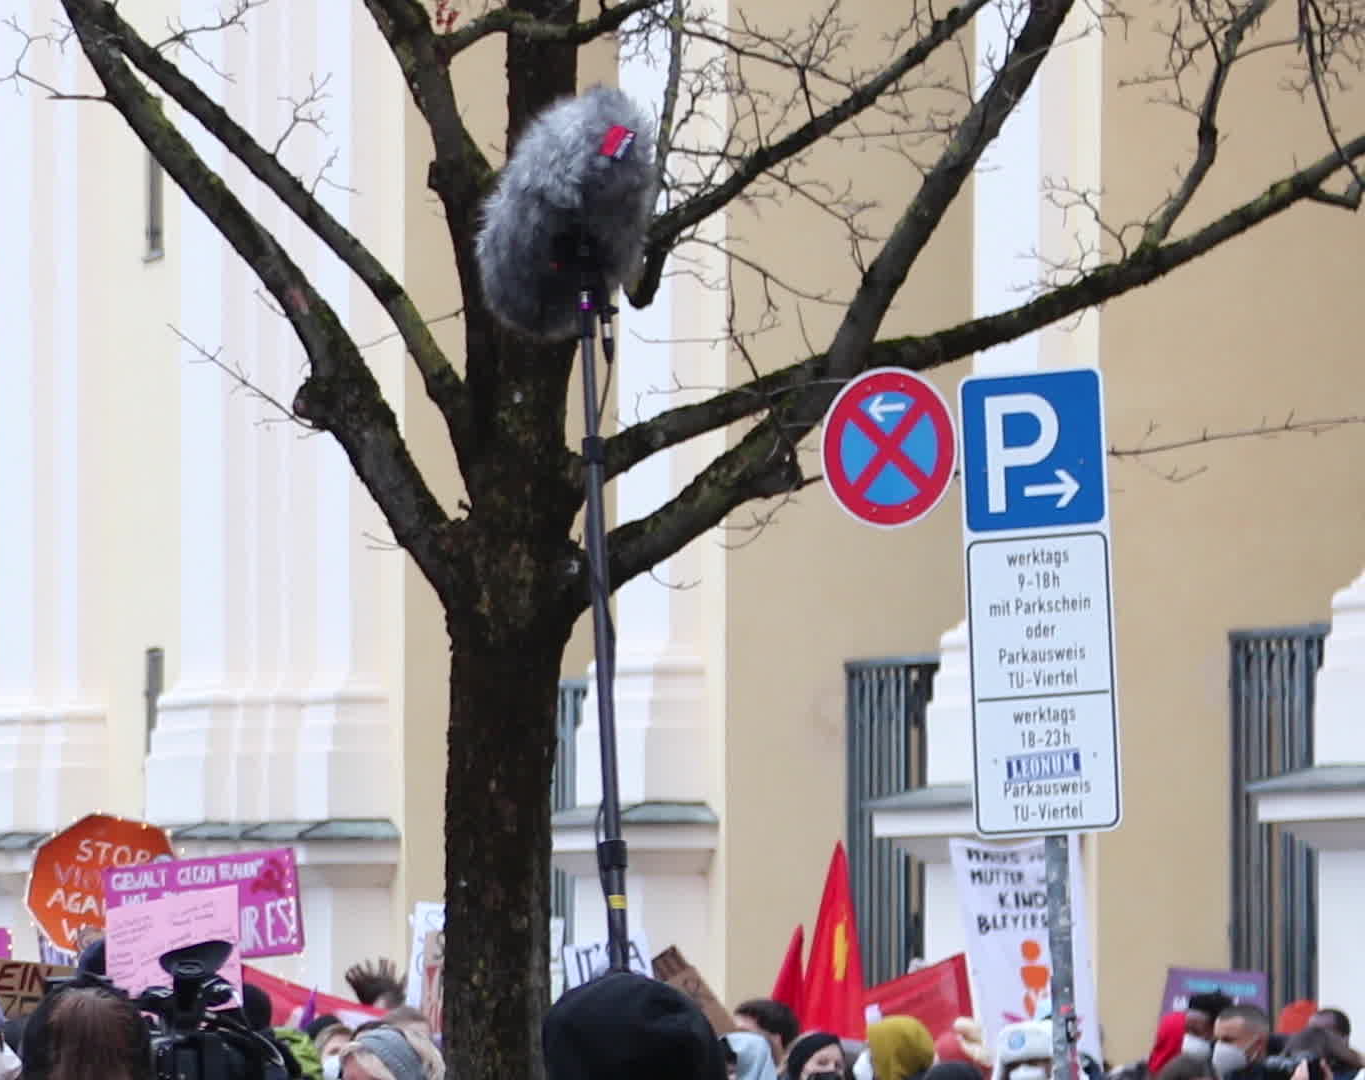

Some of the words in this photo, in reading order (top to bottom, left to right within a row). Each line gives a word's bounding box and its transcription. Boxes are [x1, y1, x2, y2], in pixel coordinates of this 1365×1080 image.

[984, 393, 1059, 513] P
[1006, 549, 1070, 568] werktags
[1018, 570, 1060, 590] 9-18h
[989, 601, 1011, 617] mit
[1015, 593, 1091, 616] Parkschein
[1025, 622, 1057, 640] oder
[998, 643, 1086, 666] Parkausweis
[1008, 668, 1078, 689] TU-Viertel
[1013, 706, 1076, 725] werktags
[1021, 728, 1071, 748] 18-23h
[1004, 776, 1091, 801] Parkausweis
[1013, 801, 1084, 823] TU-Viertel
